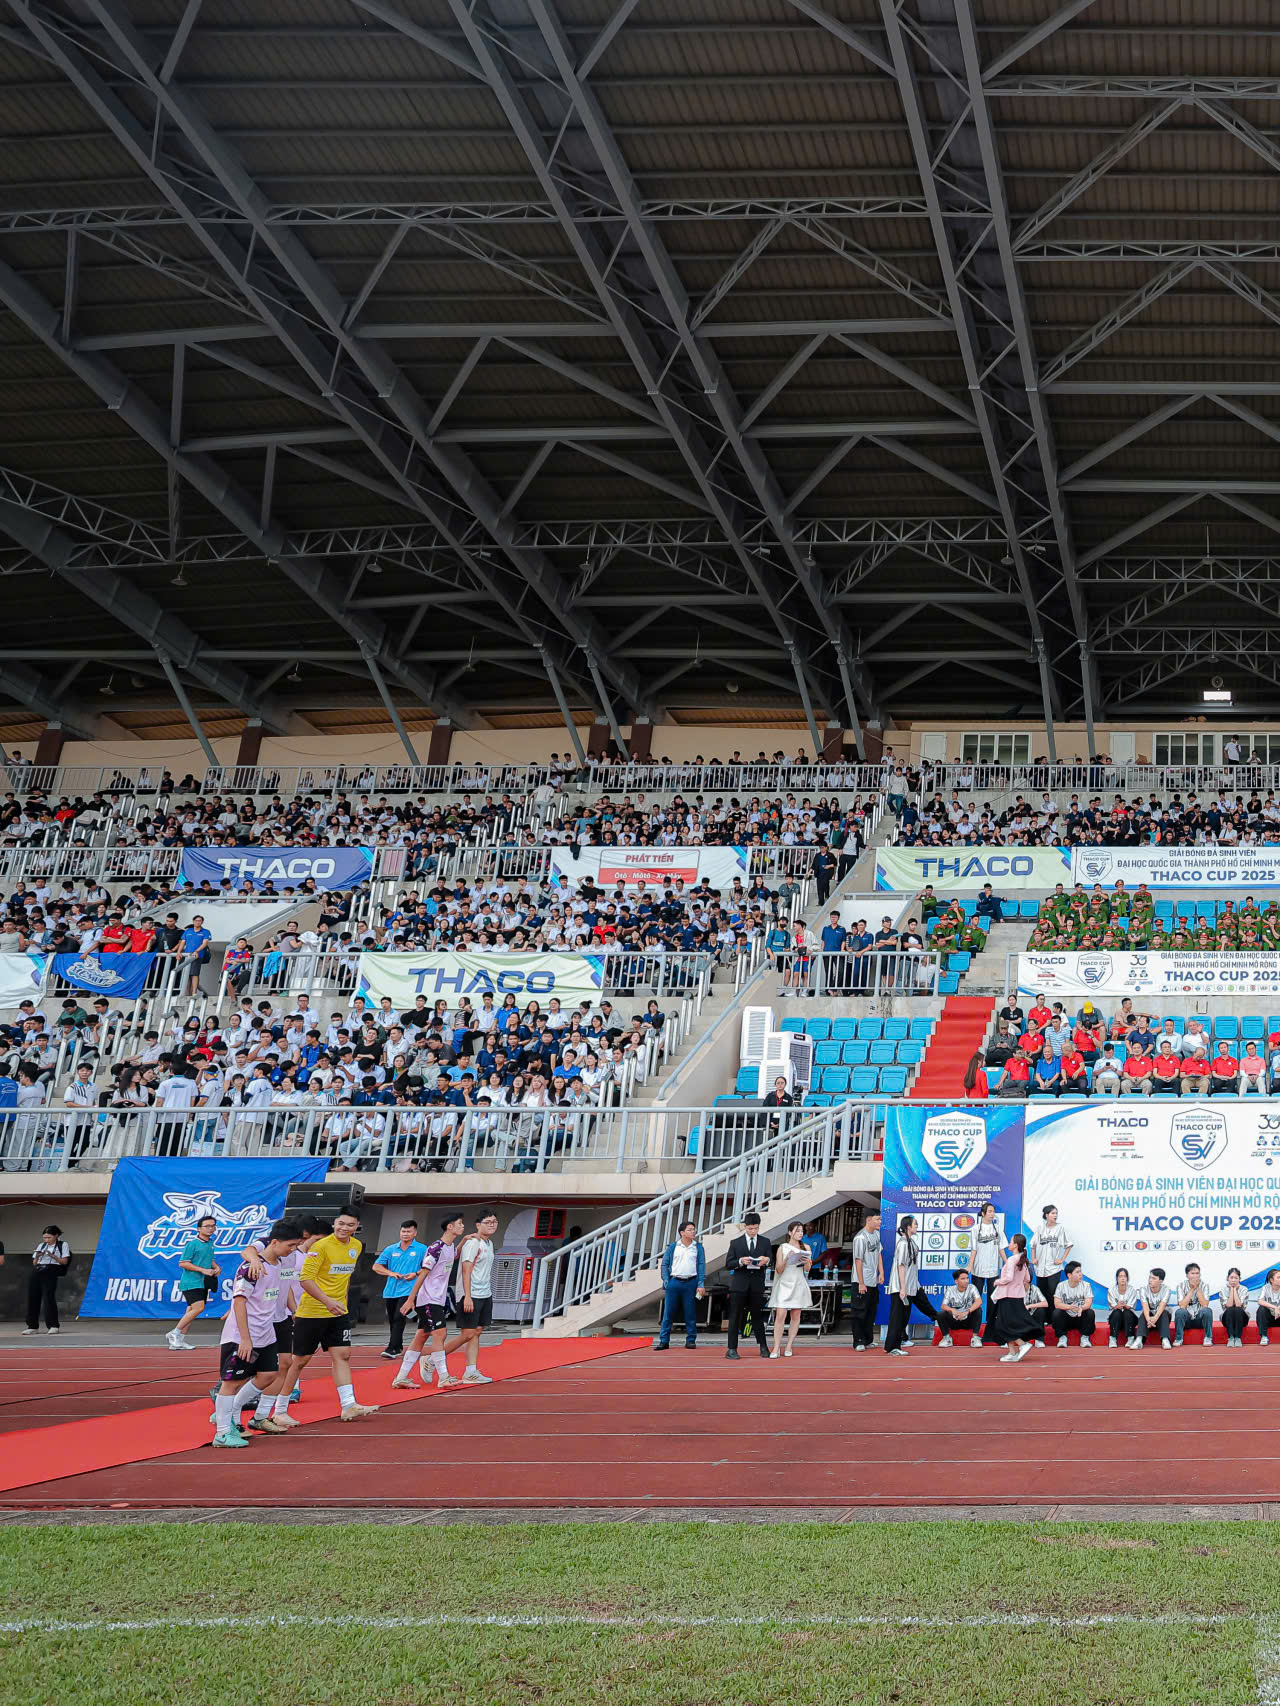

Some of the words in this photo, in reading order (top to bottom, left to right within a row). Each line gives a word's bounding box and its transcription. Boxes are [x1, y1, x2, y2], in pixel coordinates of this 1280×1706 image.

[625, 853, 650, 863] PHÁT
[653, 852, 674, 863] TIẾN
[1169, 848, 1184, 857] GIẢI
[1185, 848, 1206, 857] BÓNG
[1207, 848, 1217, 857] ĐÁ
[1219, 849, 1237, 857] SINH
[1239, 848, 1256, 857] VIÊN
[216, 858, 336, 879] THACO
[914, 856, 1034, 878] THACO
[1117, 859, 1131, 869] ĐẠI
[1131, 859, 1147, 869] HỌC
[1148, 857, 1168, 868] QUỐC
[1169, 859, 1181, 868] GIA
[1184, 857, 1209, 868] THÀNH
[1210, 857, 1226, 868] PHỐ
[1240, 857, 1252, 868] CHÍ
[1253, 859, 1273, 867] MINH
[1150, 870, 1202, 881] THACO
[1206, 870, 1237, 881] CUP
[1241, 870, 1275, 881] 2025
[1028, 957, 1066, 965] THACO
[1160, 952, 1174, 960] GIẢI
[1175, 952, 1192, 960] BÓNG
[1193, 952, 1202, 960] ĐÁ
[1203, 952, 1218, 960] SINH
[1220, 952, 1235, 960] VIÊN
[1235, 952, 1247, 960] ĐẠI
[1248, 952, 1259, 960] HỌC
[1260, 951, 1277, 960] QUỐC
[1173, 960, 1195, 968] THÀNH
[1196, 960, 1209, 968] PHỐ
[1220, 960, 1231, 968] CHÍ
[1232, 960, 1248, 968] MINH
[1260, 960, 1277, 969] RỘNG
[407, 967, 556, 993] THACO
[1164, 970, 1215, 981] THACO
[1219, 970, 1249, 981] CUP
[1097, 1117, 1149, 1128] THACO
[1175, 1123, 1204, 1131] THACO
[1205, 1123, 1223, 1131] CUP
[928, 1128, 960, 1136] THACO
[962, 1128, 982, 1136] CUP
[1181, 1134, 1216, 1160] SV
[934, 1140, 974, 1171] SV
[1074, 1175, 1099, 1191] GIẢI
[1101, 1175, 1134, 1191] BÓNG
[1136, 1175, 1153, 1191] ĐÁ
[1155, 1177, 1184, 1190] SINH
[1187, 1174, 1215, 1190] VIÊN
[1217, 1177, 1237, 1192] ĐẠI
[1240, 1177, 1264, 1192] HỌC
[915, 1200, 945, 1208] THACO
[947, 1200, 965, 1208] CUP
[1098, 1194, 1140, 1209] THÀNH
[1142, 1193, 1166, 1209] PHỐ
[1168, 1192, 1185, 1208] HỒ
[1188, 1193, 1208, 1208] CHÍ
[1210, 1195, 1240, 1208] MINH
[1243, 1192, 1261, 1208] MỞ
[1112, 1215, 1184, 1231] THACO
[1190, 1215, 1233, 1231] CUP
[146, 1224, 272, 1248] HCUT
[926, 1254, 944, 1263] UEH
[105, 1278, 168, 1301] HCMUT
